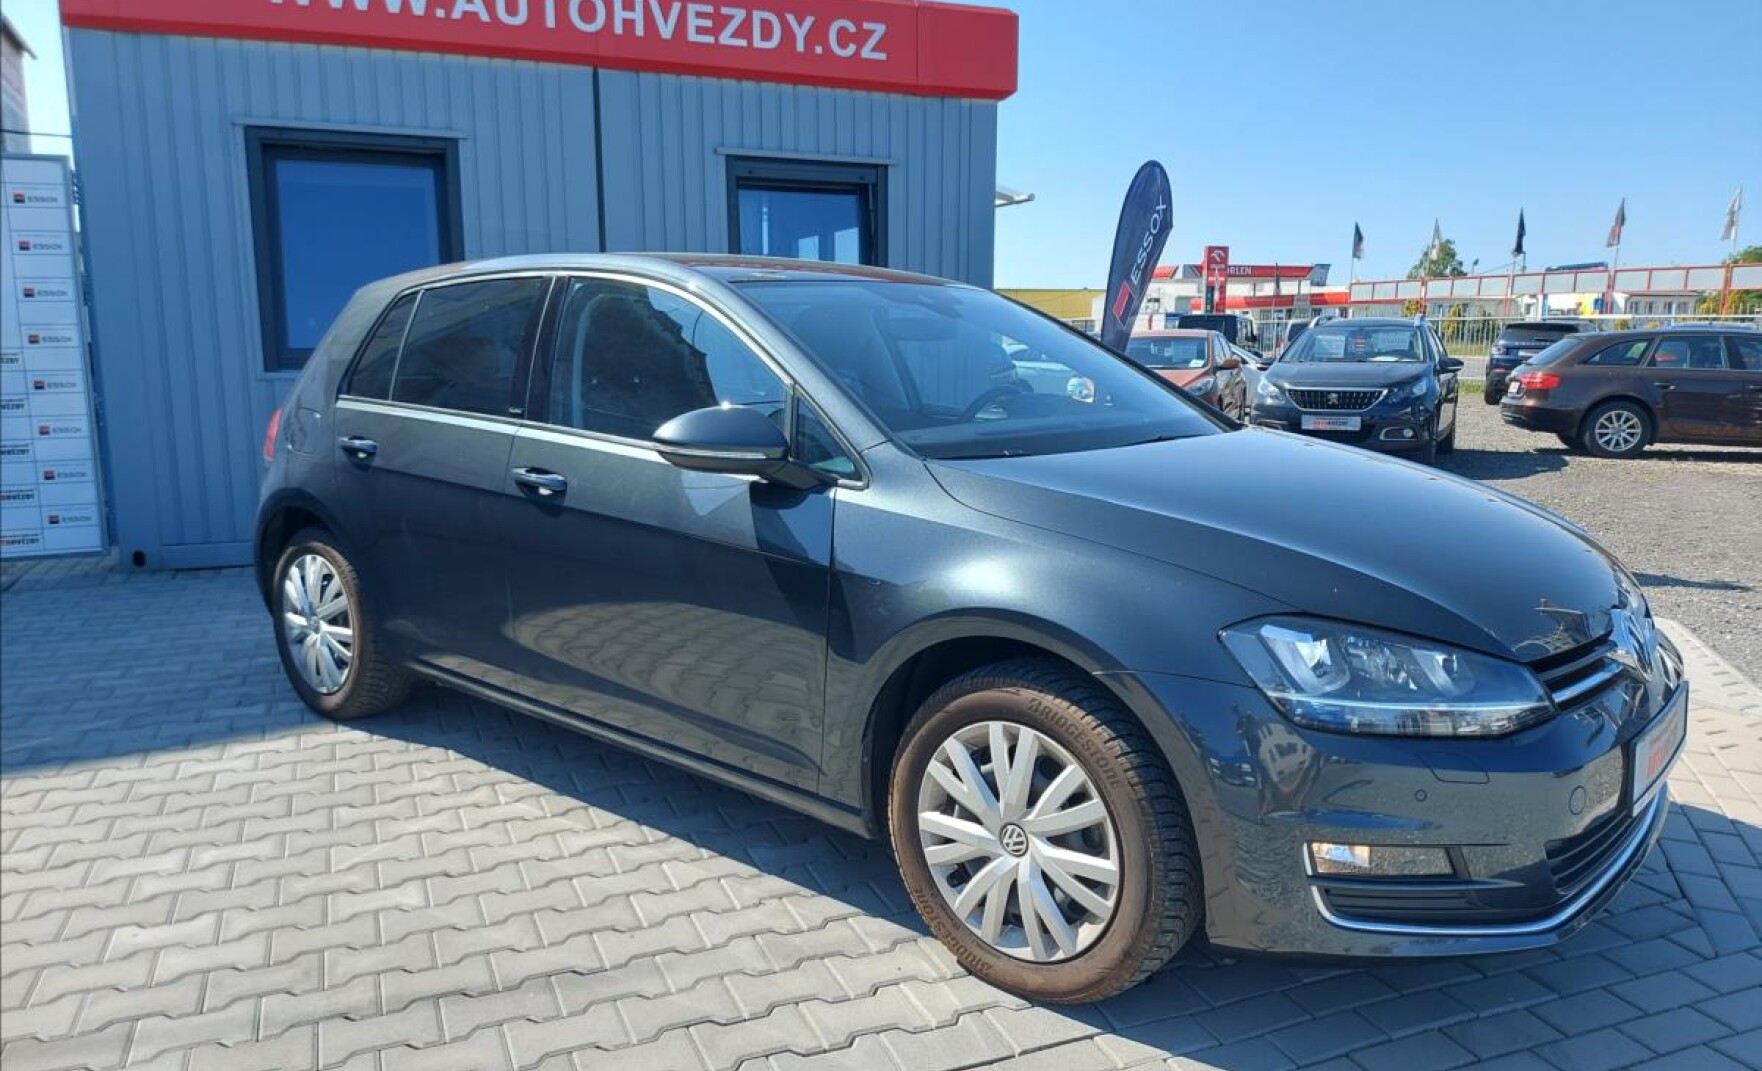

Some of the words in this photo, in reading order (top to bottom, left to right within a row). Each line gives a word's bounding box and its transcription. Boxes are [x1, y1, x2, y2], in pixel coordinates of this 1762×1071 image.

[270, 0, 888, 61] .AUTOHVEZDY.CZ
[1131, 194, 1166, 285] ESSOX
[1227, 266, 1252, 275] RLEN
